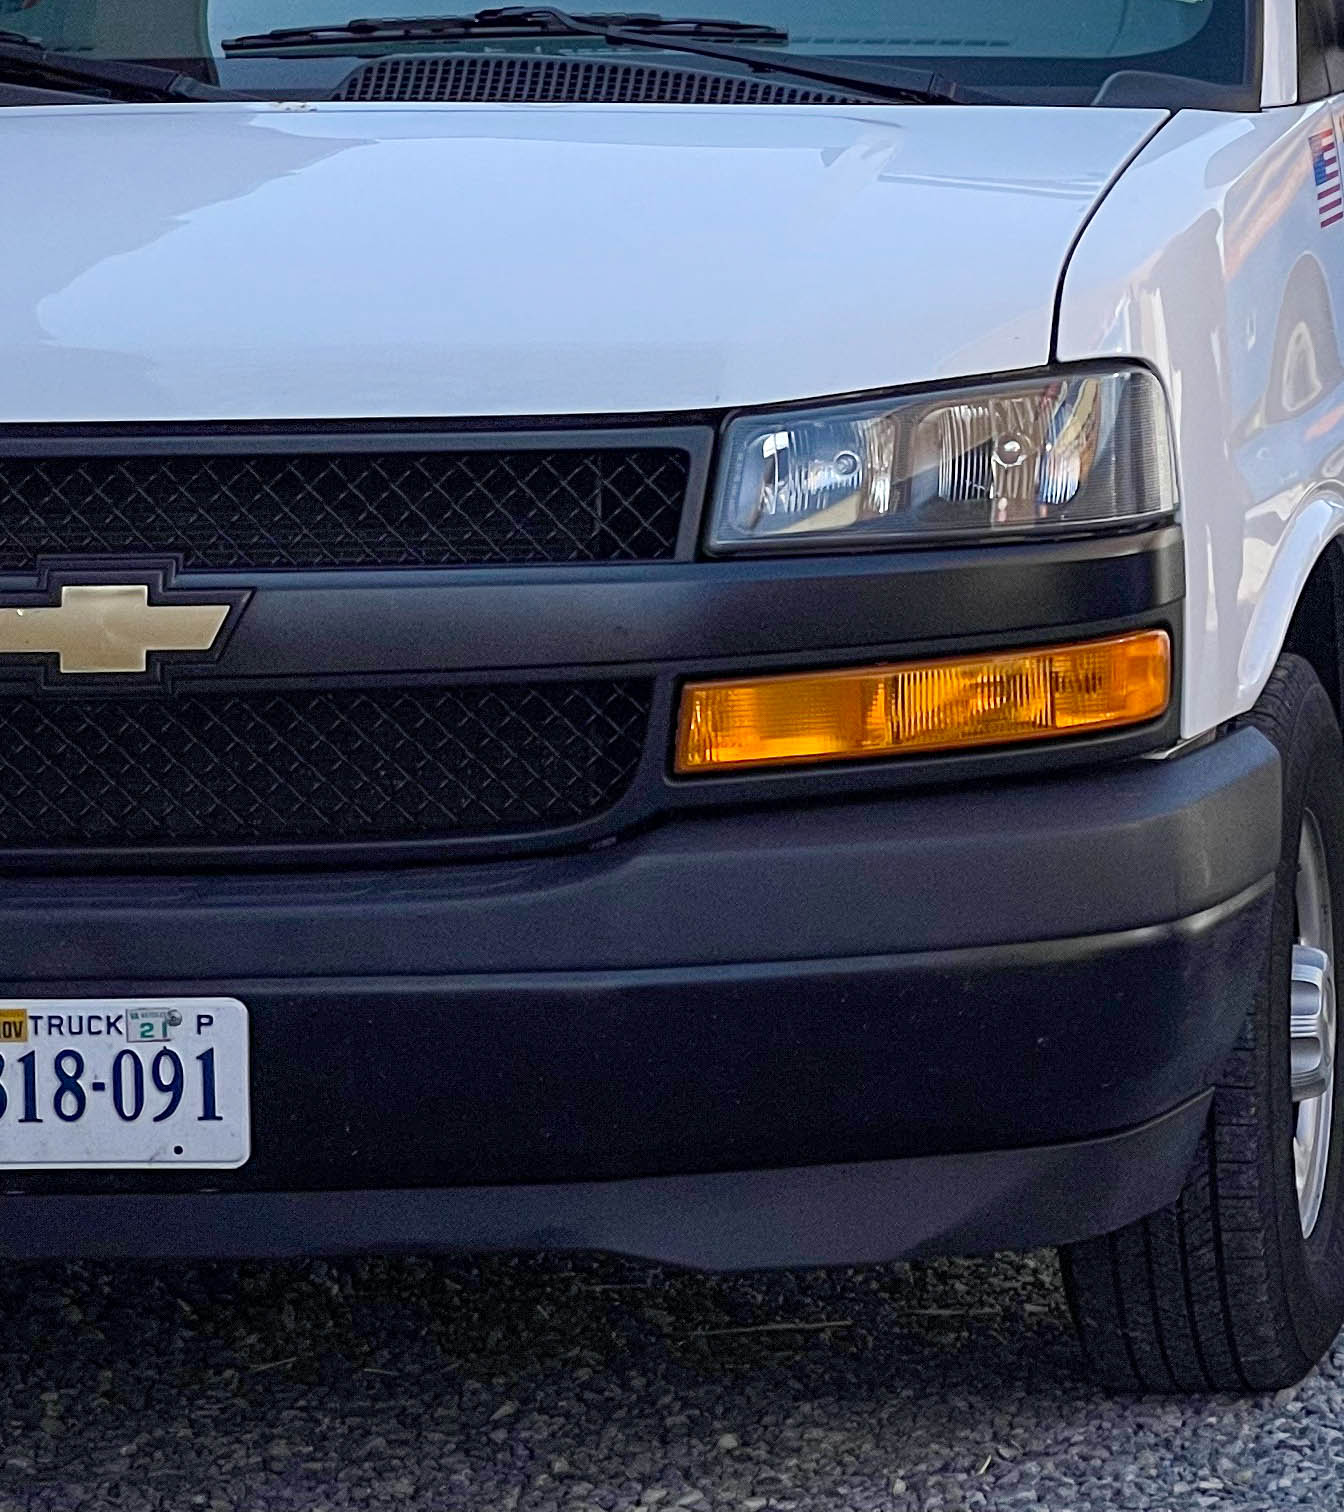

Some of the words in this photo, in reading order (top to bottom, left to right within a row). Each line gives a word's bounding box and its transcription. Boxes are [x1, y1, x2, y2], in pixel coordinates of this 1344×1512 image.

[0, 1021, 23, 1039] OV
[29, 1014, 124, 1036] TRUCK
[140, 1022, 168, 1039] 21
[196, 1014, 214, 1036] P
[0, 1046, 223, 1123] 18-091
